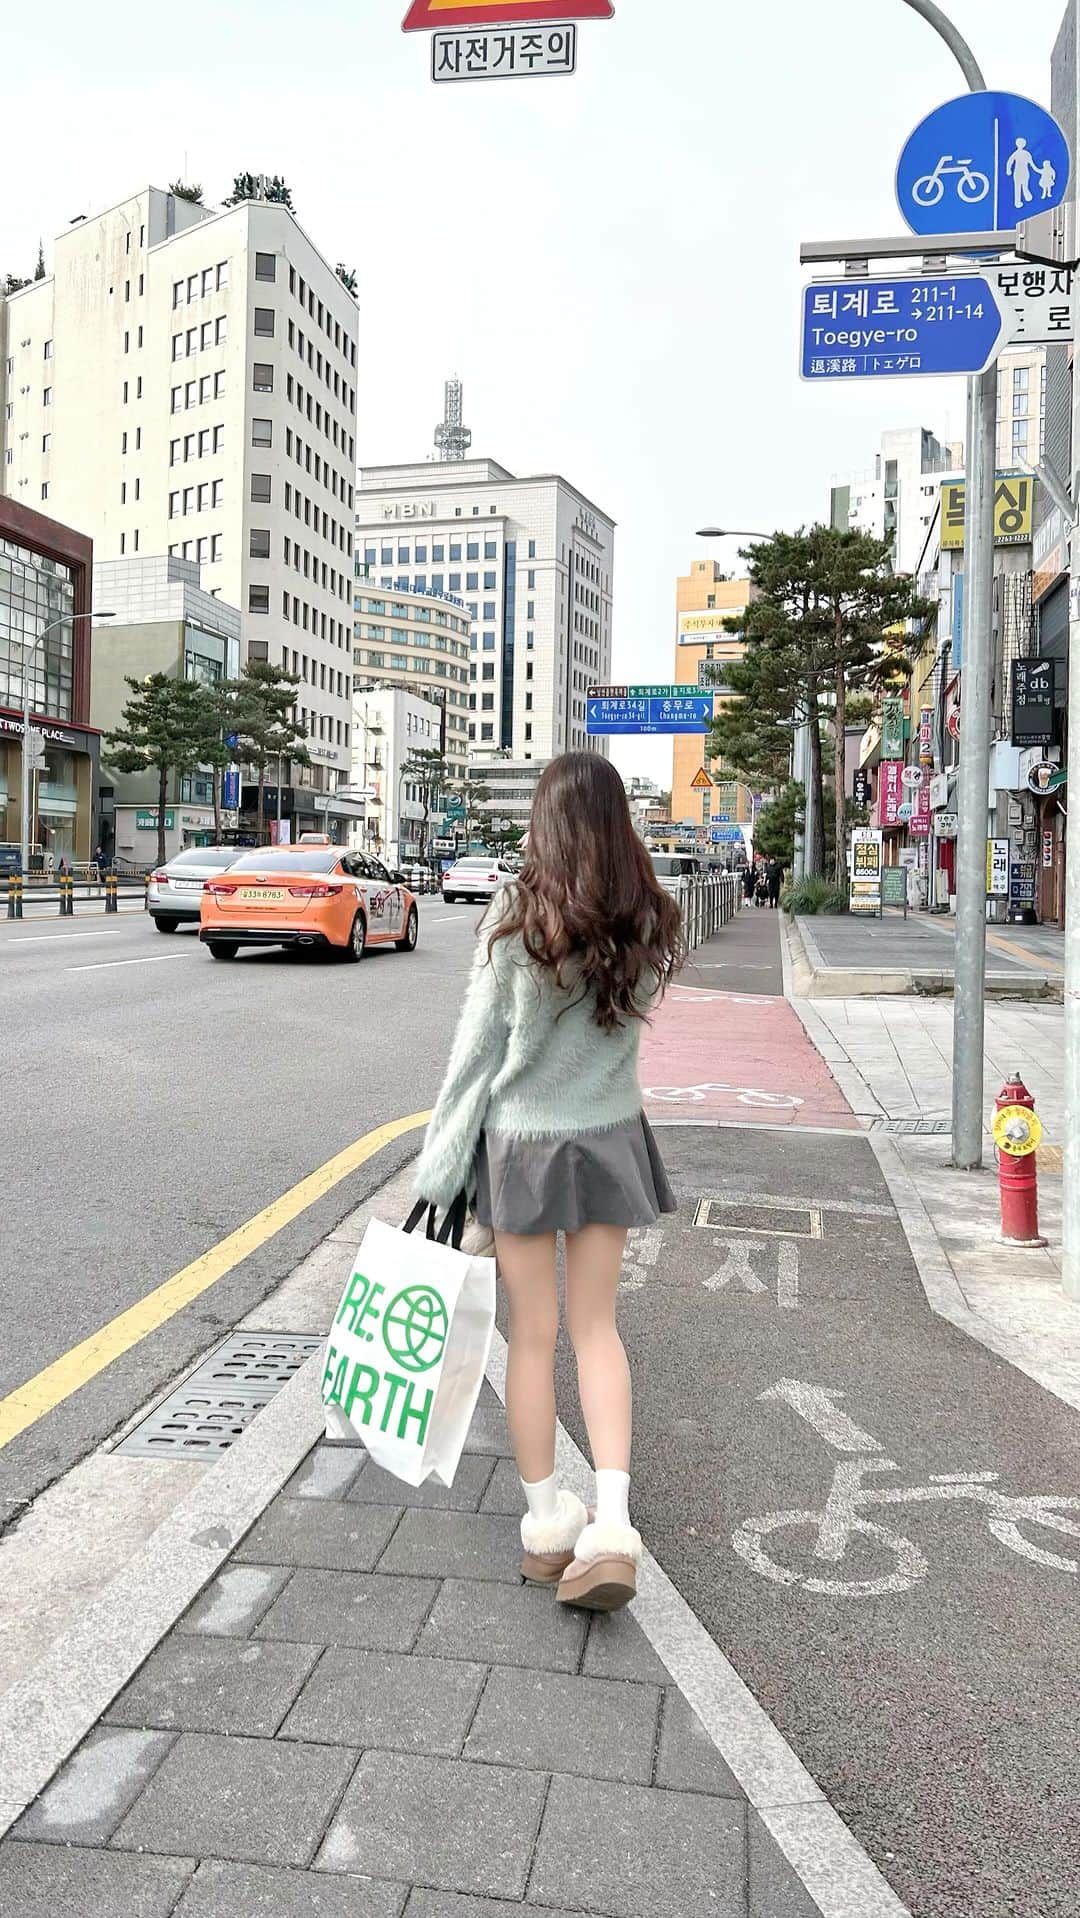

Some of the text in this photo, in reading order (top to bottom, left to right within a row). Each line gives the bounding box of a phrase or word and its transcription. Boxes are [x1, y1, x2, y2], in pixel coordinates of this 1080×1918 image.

[438, 32, 570, 73] 자전거주의
[812, 286, 956, 319] 퇴계로 211-1
[926, 303, 984, 321] 211-14
[812, 327, 918, 347] Toegye-ro
[811, 358, 857, 373] 退溪路
[383, 502, 434, 519] MBN
[1016, 662, 1027, 706] 노래주점
[1030, 677, 1049, 689] db
[601, 700, 645, 712] 퇴계로34길
[662, 700, 694, 712] 충무로
[41, 728, 64, 740] PLACE
[855, 844, 878, 856] 점심
[993, 842, 1007, 872] 노래
[855, 856, 878, 868] 뷔페
[336, 1271, 386, 1343] RE.
[320, 1345, 434, 1447] EARTH
